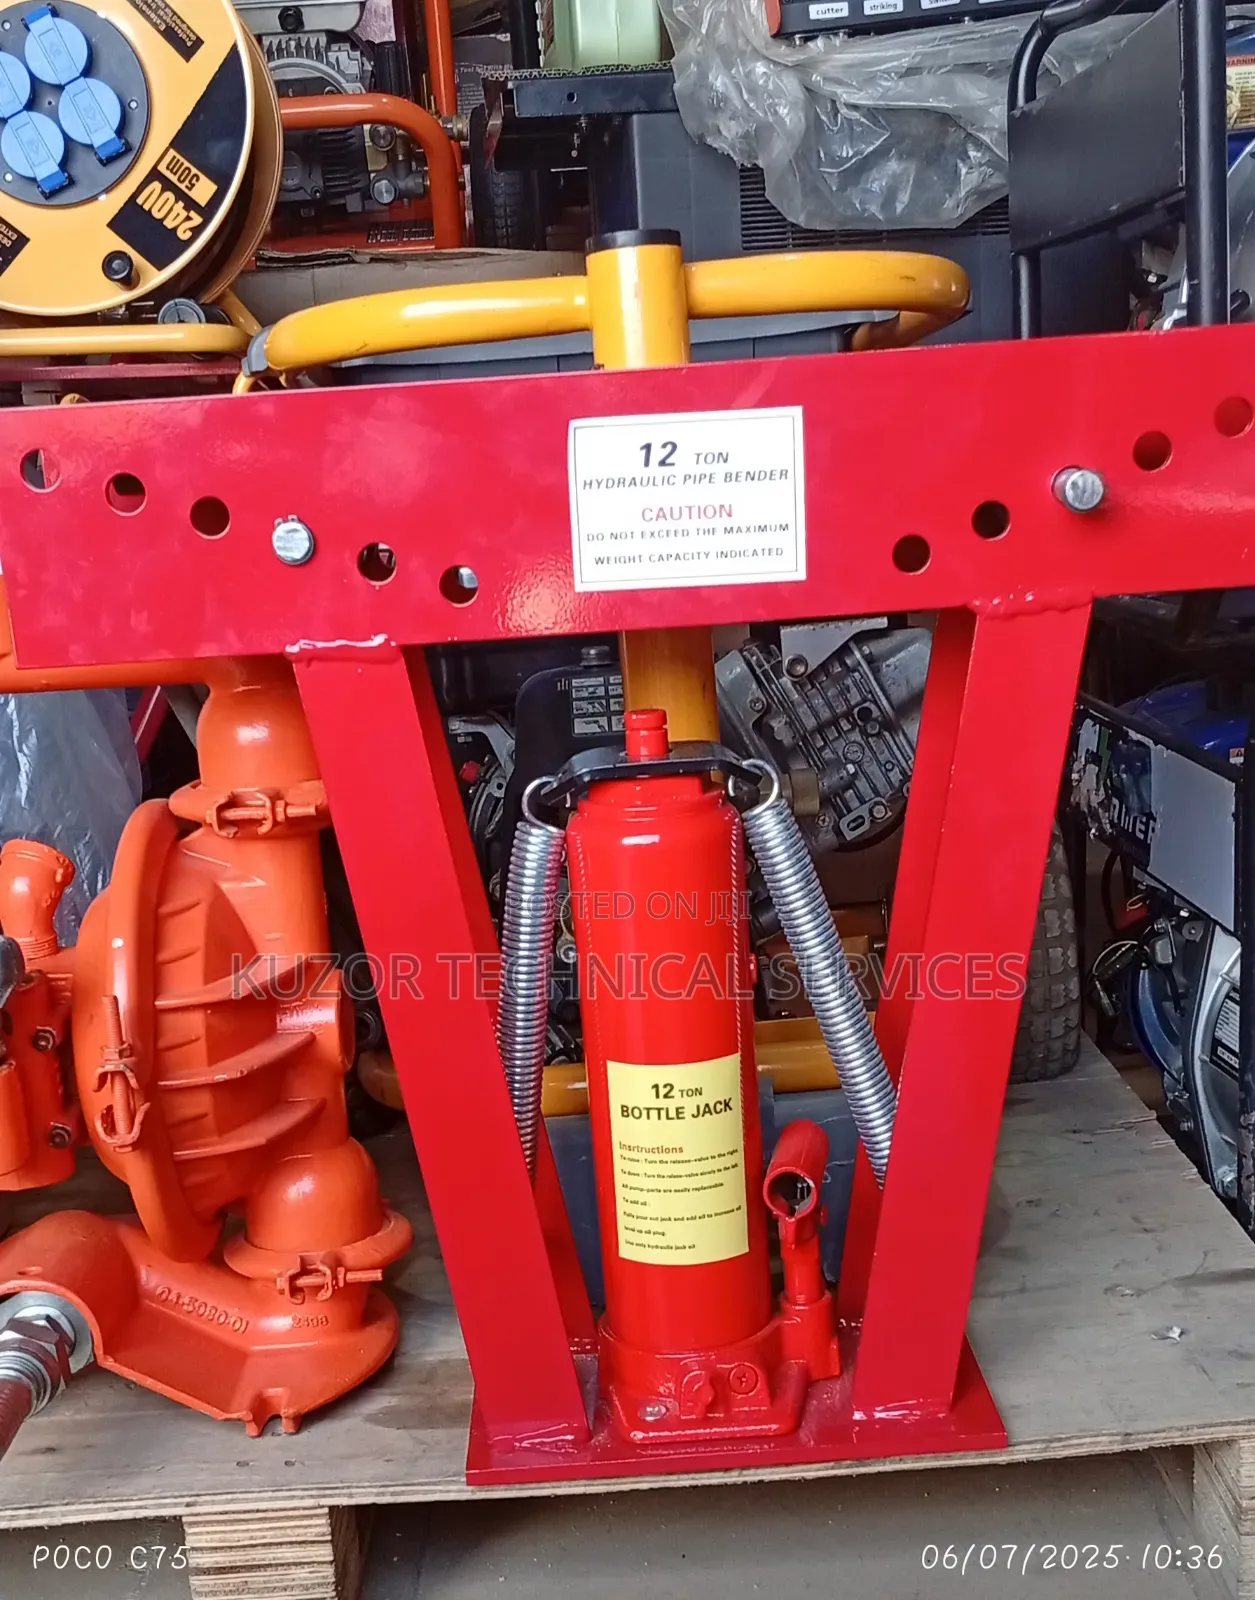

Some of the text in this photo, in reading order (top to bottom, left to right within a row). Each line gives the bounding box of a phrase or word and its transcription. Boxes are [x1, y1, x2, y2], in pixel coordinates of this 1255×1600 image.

[816, 7, 844, 15] cutter
[869, 2, 898, 11] striking
[165, 154, 201, 192] 50m
[135, 180, 204, 241] 240V
[639, 441, 730, 468] 12 TON
[582, 468, 790, 490] HYDRAULIC PIPE BENDER
[641, 503, 734, 523] CAUTION
[586, 523, 790, 543] DO NOT EXCEED THE MAXIMUM
[594, 547, 784, 566] WEIGHT CAPACITY INDICATED
[651, 1082, 704, 1100] 12 TON
[620, 1097, 733, 1121] BOTTLE JACK
